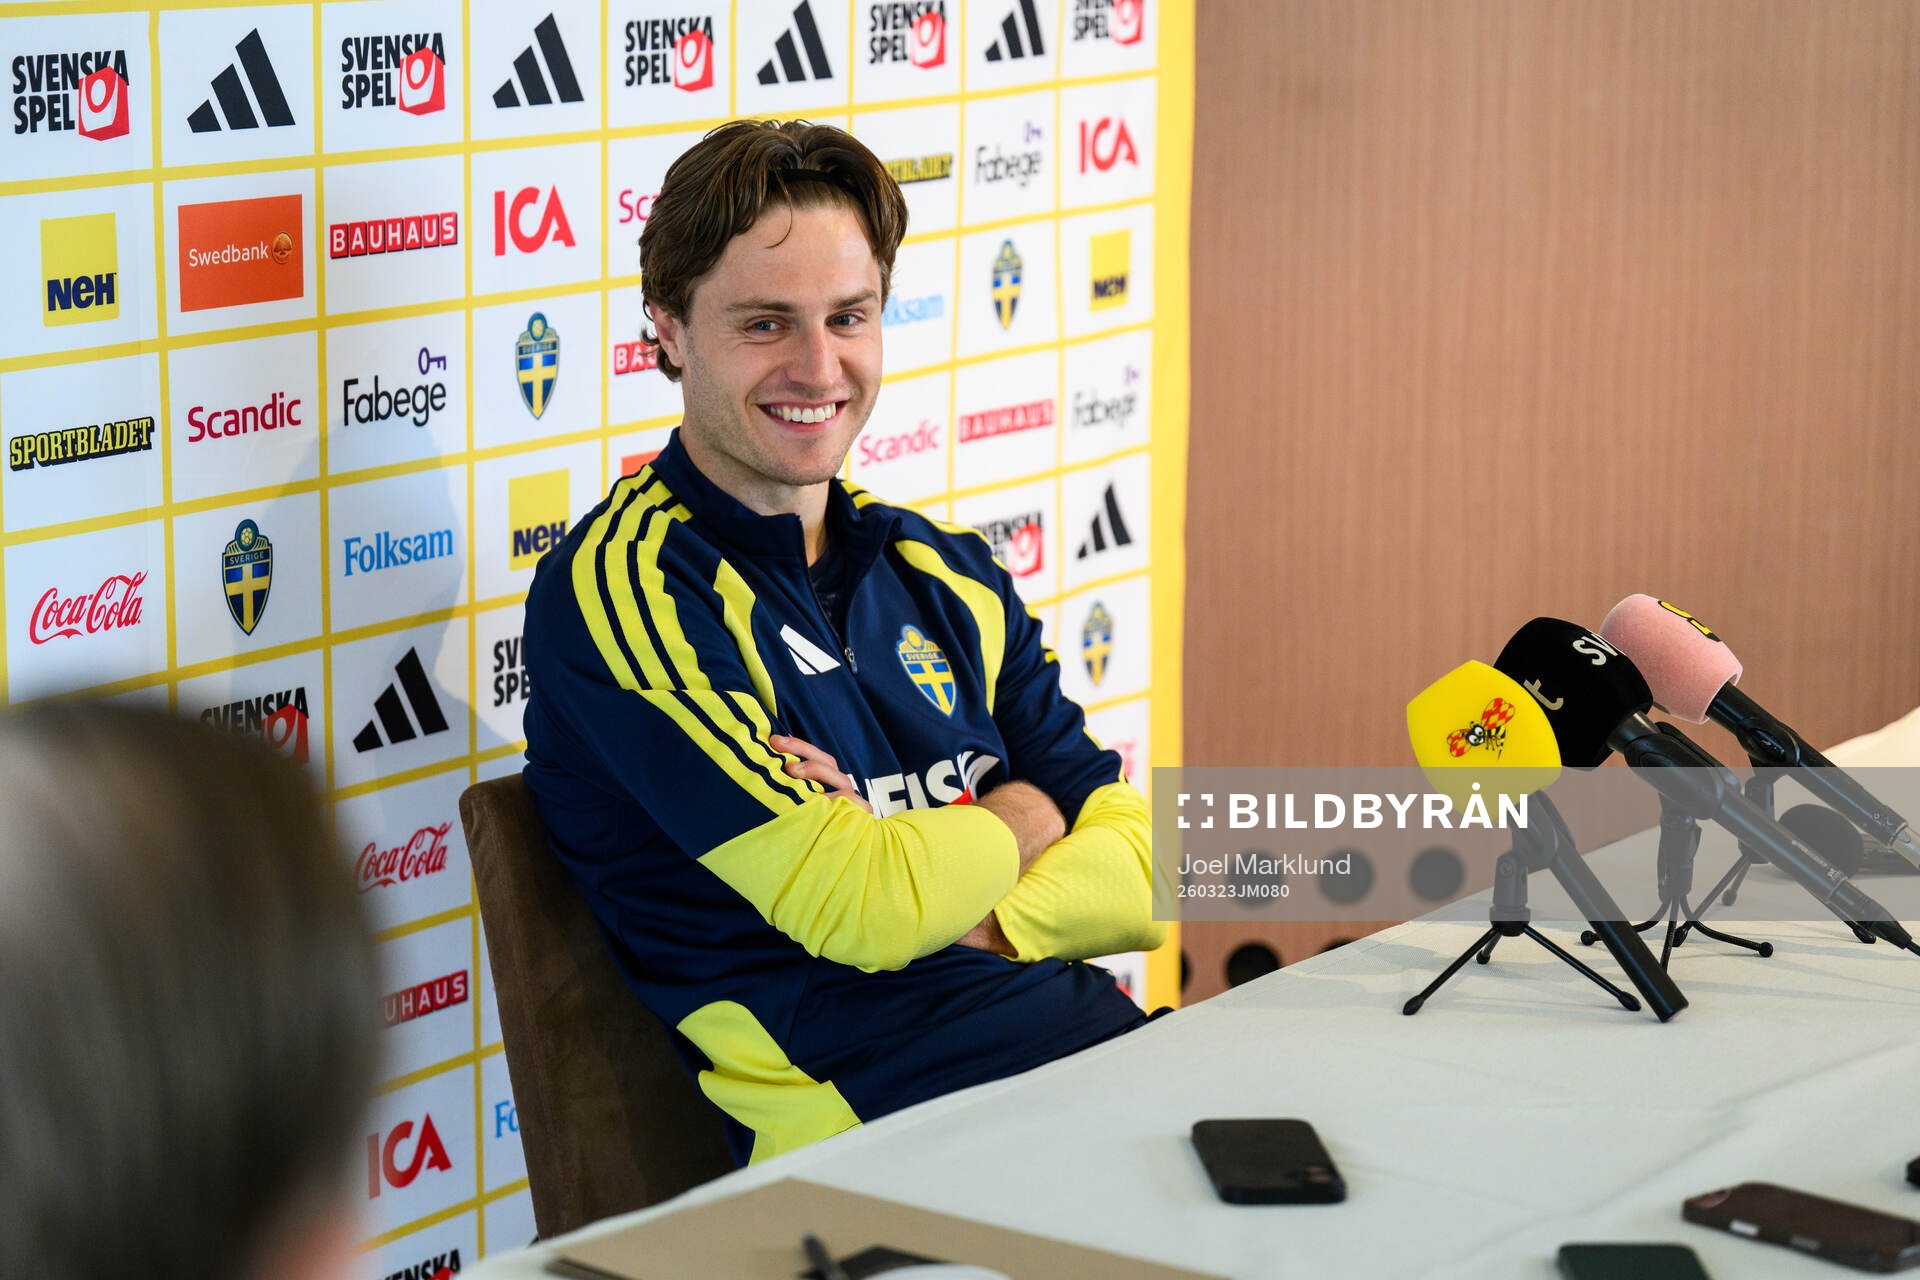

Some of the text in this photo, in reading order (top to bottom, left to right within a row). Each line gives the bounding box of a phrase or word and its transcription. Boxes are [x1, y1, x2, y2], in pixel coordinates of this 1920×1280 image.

[625, 53, 671, 87] SPEL
[869, 35, 908, 64] SPEL
[342, 72, 396, 110] SPEL
[13, 93, 76, 135] SPEL
[1079, 117, 1140, 174] ICA
[332, 216, 456, 253] BAUHAUS
[494, 184, 577, 256] ICA
[189, 241, 269, 267] Swedbank
[187, 391, 302, 443] Scandic
[343, 375, 447, 427] Fabege
[961, 402, 1053, 441] BAUHAUS
[10, 416, 154, 471] SPORTBLADET
[859, 418, 943, 467] Scandic
[229, 550, 265, 565] SVERIGE
[344, 528, 453, 576] Folksam
[494, 671, 530, 707] SPE
[384, 974, 467, 1023] UHAUS
[367, 1113, 452, 1200] ICA
